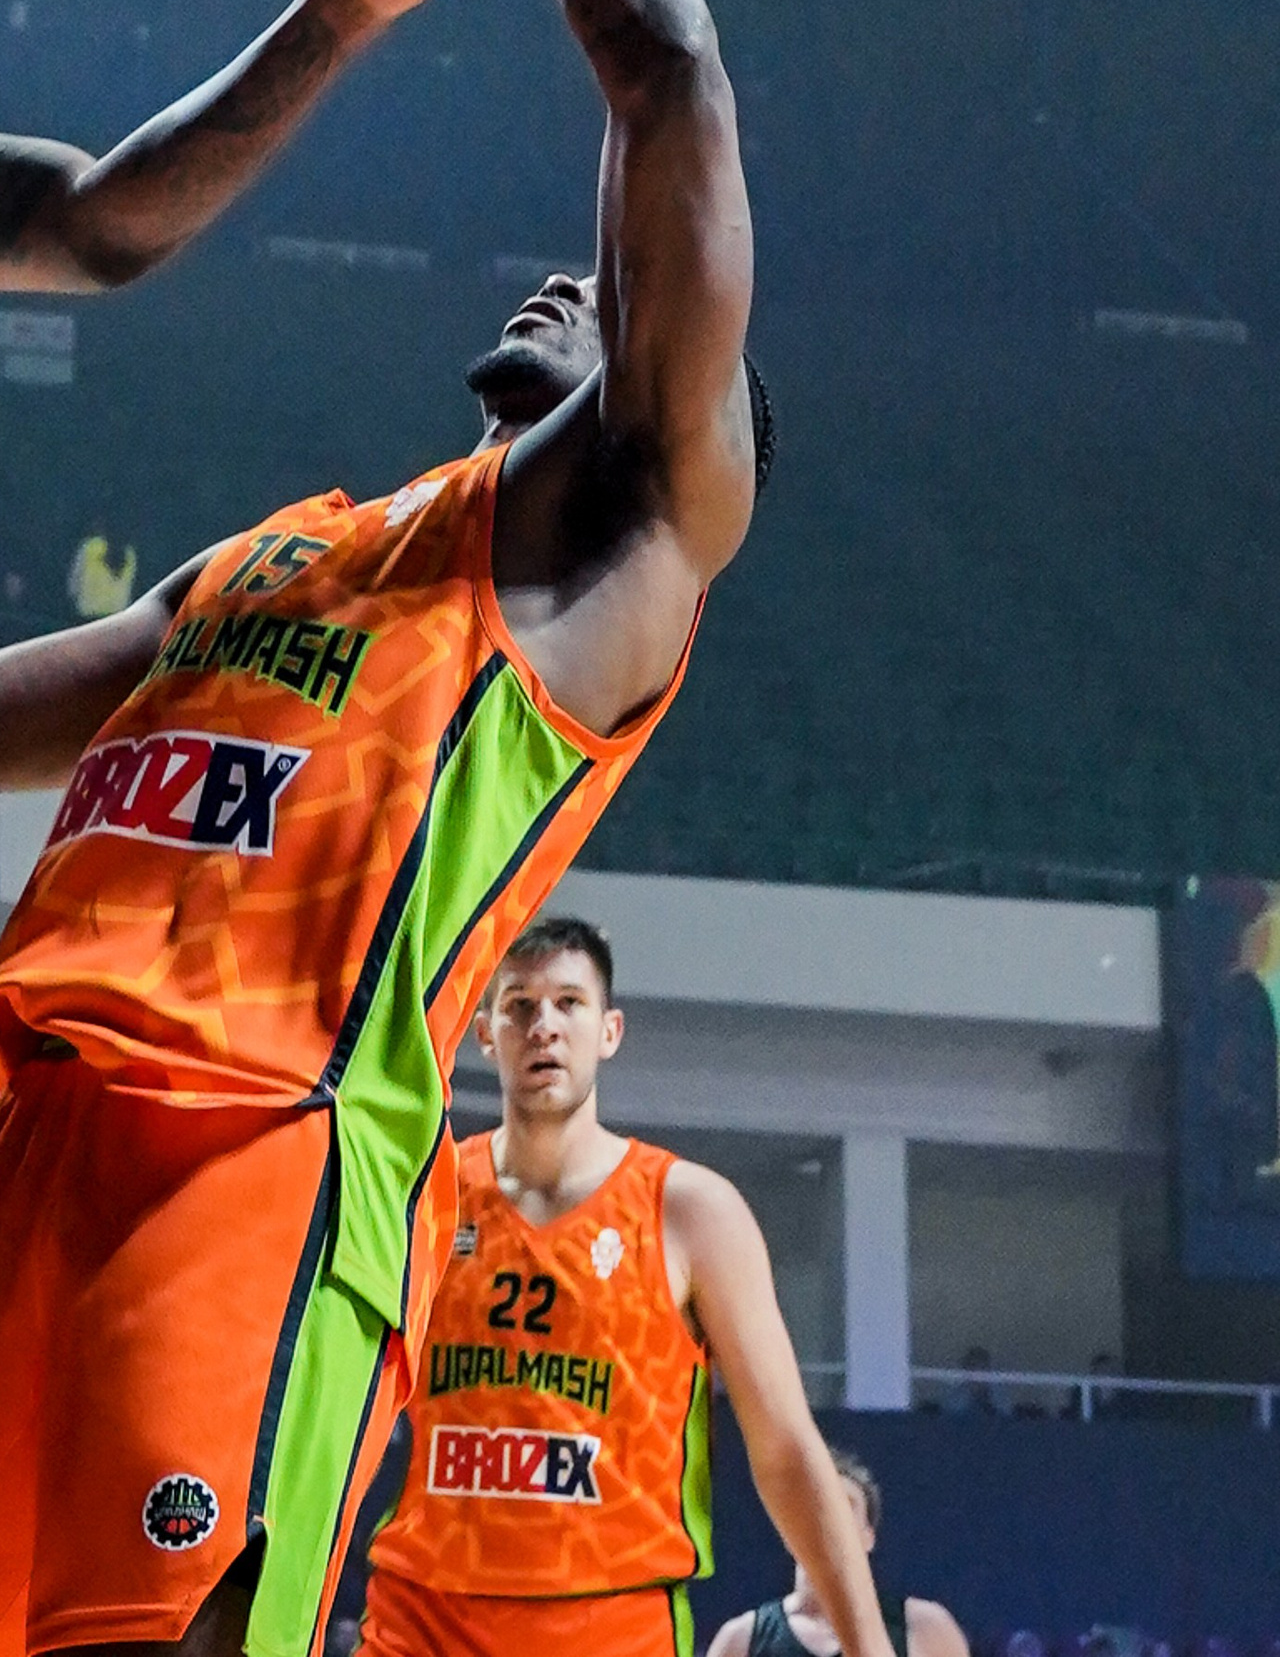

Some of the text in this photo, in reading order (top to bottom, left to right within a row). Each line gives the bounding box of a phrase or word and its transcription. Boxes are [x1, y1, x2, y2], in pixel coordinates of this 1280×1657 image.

[221, 530, 334, 597] 15
[487, 1270, 557, 1334] 22
[429, 1341, 614, 1415] URALMASH
[433, 1431, 598, 1499] BROZEX
